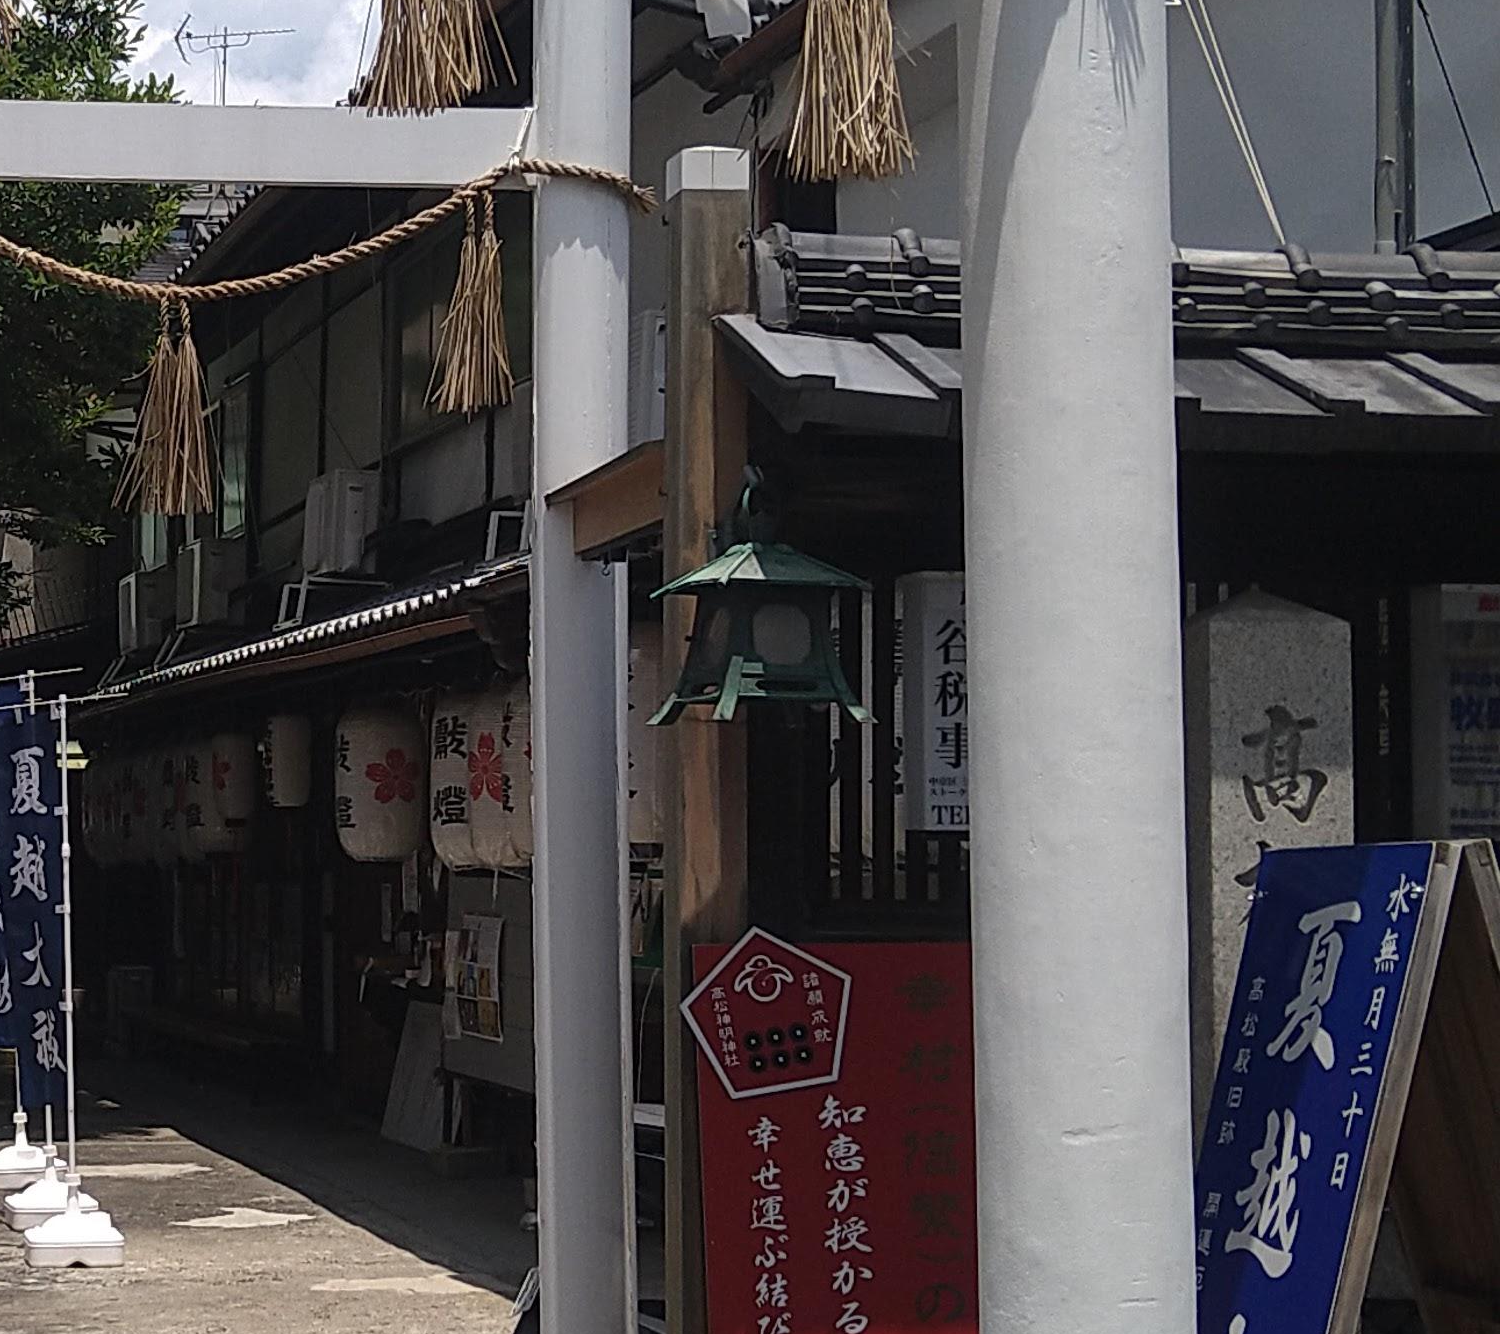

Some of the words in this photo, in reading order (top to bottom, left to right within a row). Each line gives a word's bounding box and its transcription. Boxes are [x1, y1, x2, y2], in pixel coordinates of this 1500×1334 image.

[9, 745, 68, 1074] 夏越大祓
[802, 971, 833, 1043] 諸願成就
[710, 987, 740, 1067] 高松神明神社
[1330, 873, 1418, 1191] 水無月三十日
